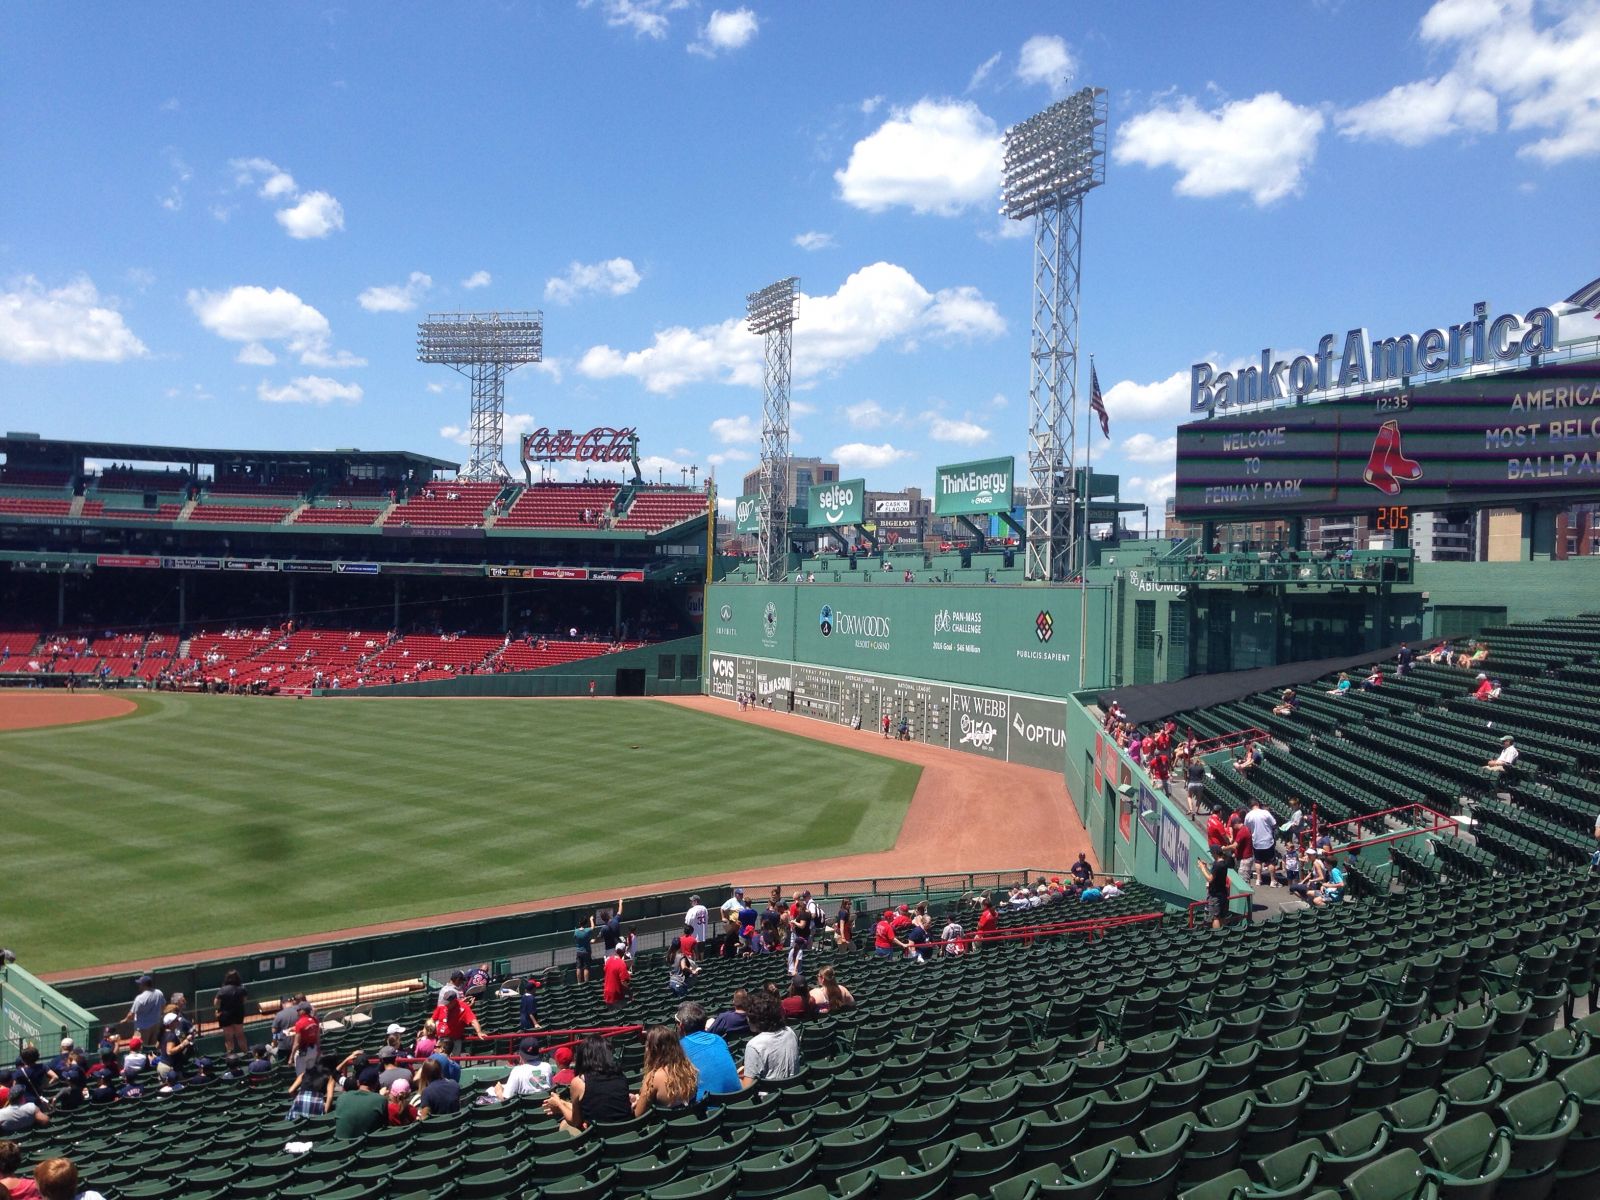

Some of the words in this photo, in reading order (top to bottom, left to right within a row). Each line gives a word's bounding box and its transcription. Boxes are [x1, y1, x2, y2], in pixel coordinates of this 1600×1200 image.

[1376, 395, 1409, 412] 12:35
[1223, 427, 1286, 452] WELCOME
[1485, 423, 1541, 450] MOST
[1244, 457, 1260, 474] TO
[942, 472, 1007, 495] ThinkEnergy
[1205, 483, 1259, 504] FENWAY
[1264, 479, 1302, 499] PARK
[1377, 507, 1409, 530] 2:05
[953, 611, 982, 623] PAN-MASS
[952, 623, 982, 634] CHALLENGE
[719, 660, 734, 678] CVS
[712, 676, 734, 697] Health
[973, 696, 1007, 718] WEBB
